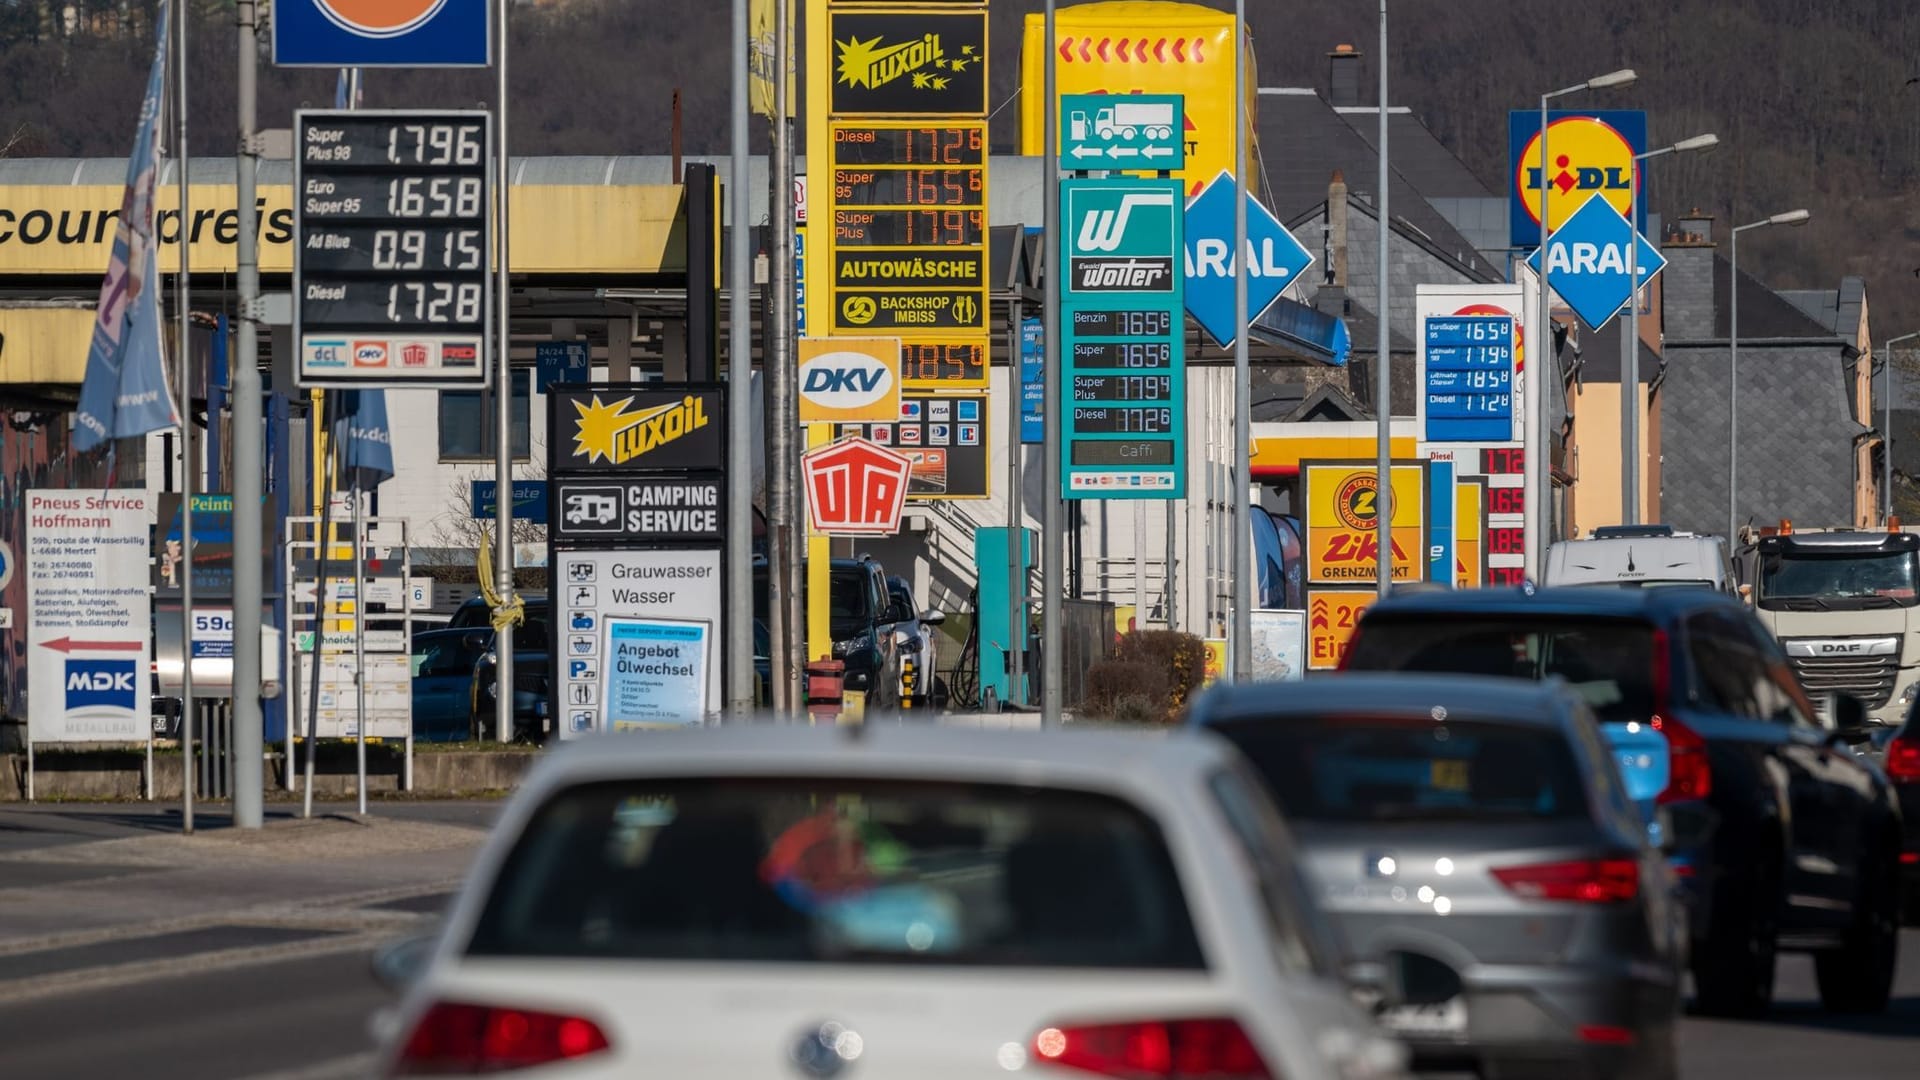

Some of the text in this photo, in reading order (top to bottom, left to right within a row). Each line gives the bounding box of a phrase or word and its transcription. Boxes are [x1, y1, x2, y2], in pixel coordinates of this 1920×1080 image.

[306, 127, 344, 144] Super
[835, 130, 875, 143] Diesel
[306, 146, 351, 160] Plus 98
[836, 171, 874, 184] Super
[306, 180, 335, 193] Euro
[836, 186, 852, 198] 95
[306, 199, 361, 215] Super 95
[836, 211, 874, 224] Super
[836, 226, 864, 239] Plus
[325, 234, 350, 248] Blue
[1547, 242, 1646, 274] ARAL
[841, 258, 977, 279] AUTOWÄSCHE
[307, 285, 346, 300] Diesel
[880, 296, 950, 309] BACKSHOP
[895, 311, 937, 324] IMBISS
[1074, 313, 1107, 323] Benzin
[1467, 322, 1509, 340] 1658
[315, 348, 337, 361] dcl
[358, 350, 383, 359] DKV
[1074, 345, 1104, 357] Super
[545, 358, 558, 366] 7/7
[803, 367, 886, 393] DKV
[1074, 376, 1105, 389] Super
[1074, 390, 1096, 400] Plus
[1430, 395, 1456, 403] Diesel
[931, 406, 949, 415] VISA
[1074, 409, 1107, 420] Diesel
[903, 430, 919, 439] DKV
[1430, 451, 1454, 460] Diesel
[811, 446, 902, 524] UTA
[628, 486, 717, 506] CAMPING
[32, 496, 144, 510] Pneus Service
[32, 515, 111, 529] Hoffmann
[628, 510, 717, 533] SERVICE
[79, 536, 90, 544] de
[92, 536, 145, 547] Wasserbillig
[64, 547, 96, 555] Mertert
[611, 563, 712, 579] Grauwasser
[414, 589, 423, 601] 6
[612, 589, 676, 604] Wasser
[617, 643, 680, 660] Angebot
[1822, 644, 1860, 652] DAF
[617, 656, 694, 676] Ölwechsel
[67, 672, 135, 691] MDK
[65, 723, 136, 734] METALLBAU
